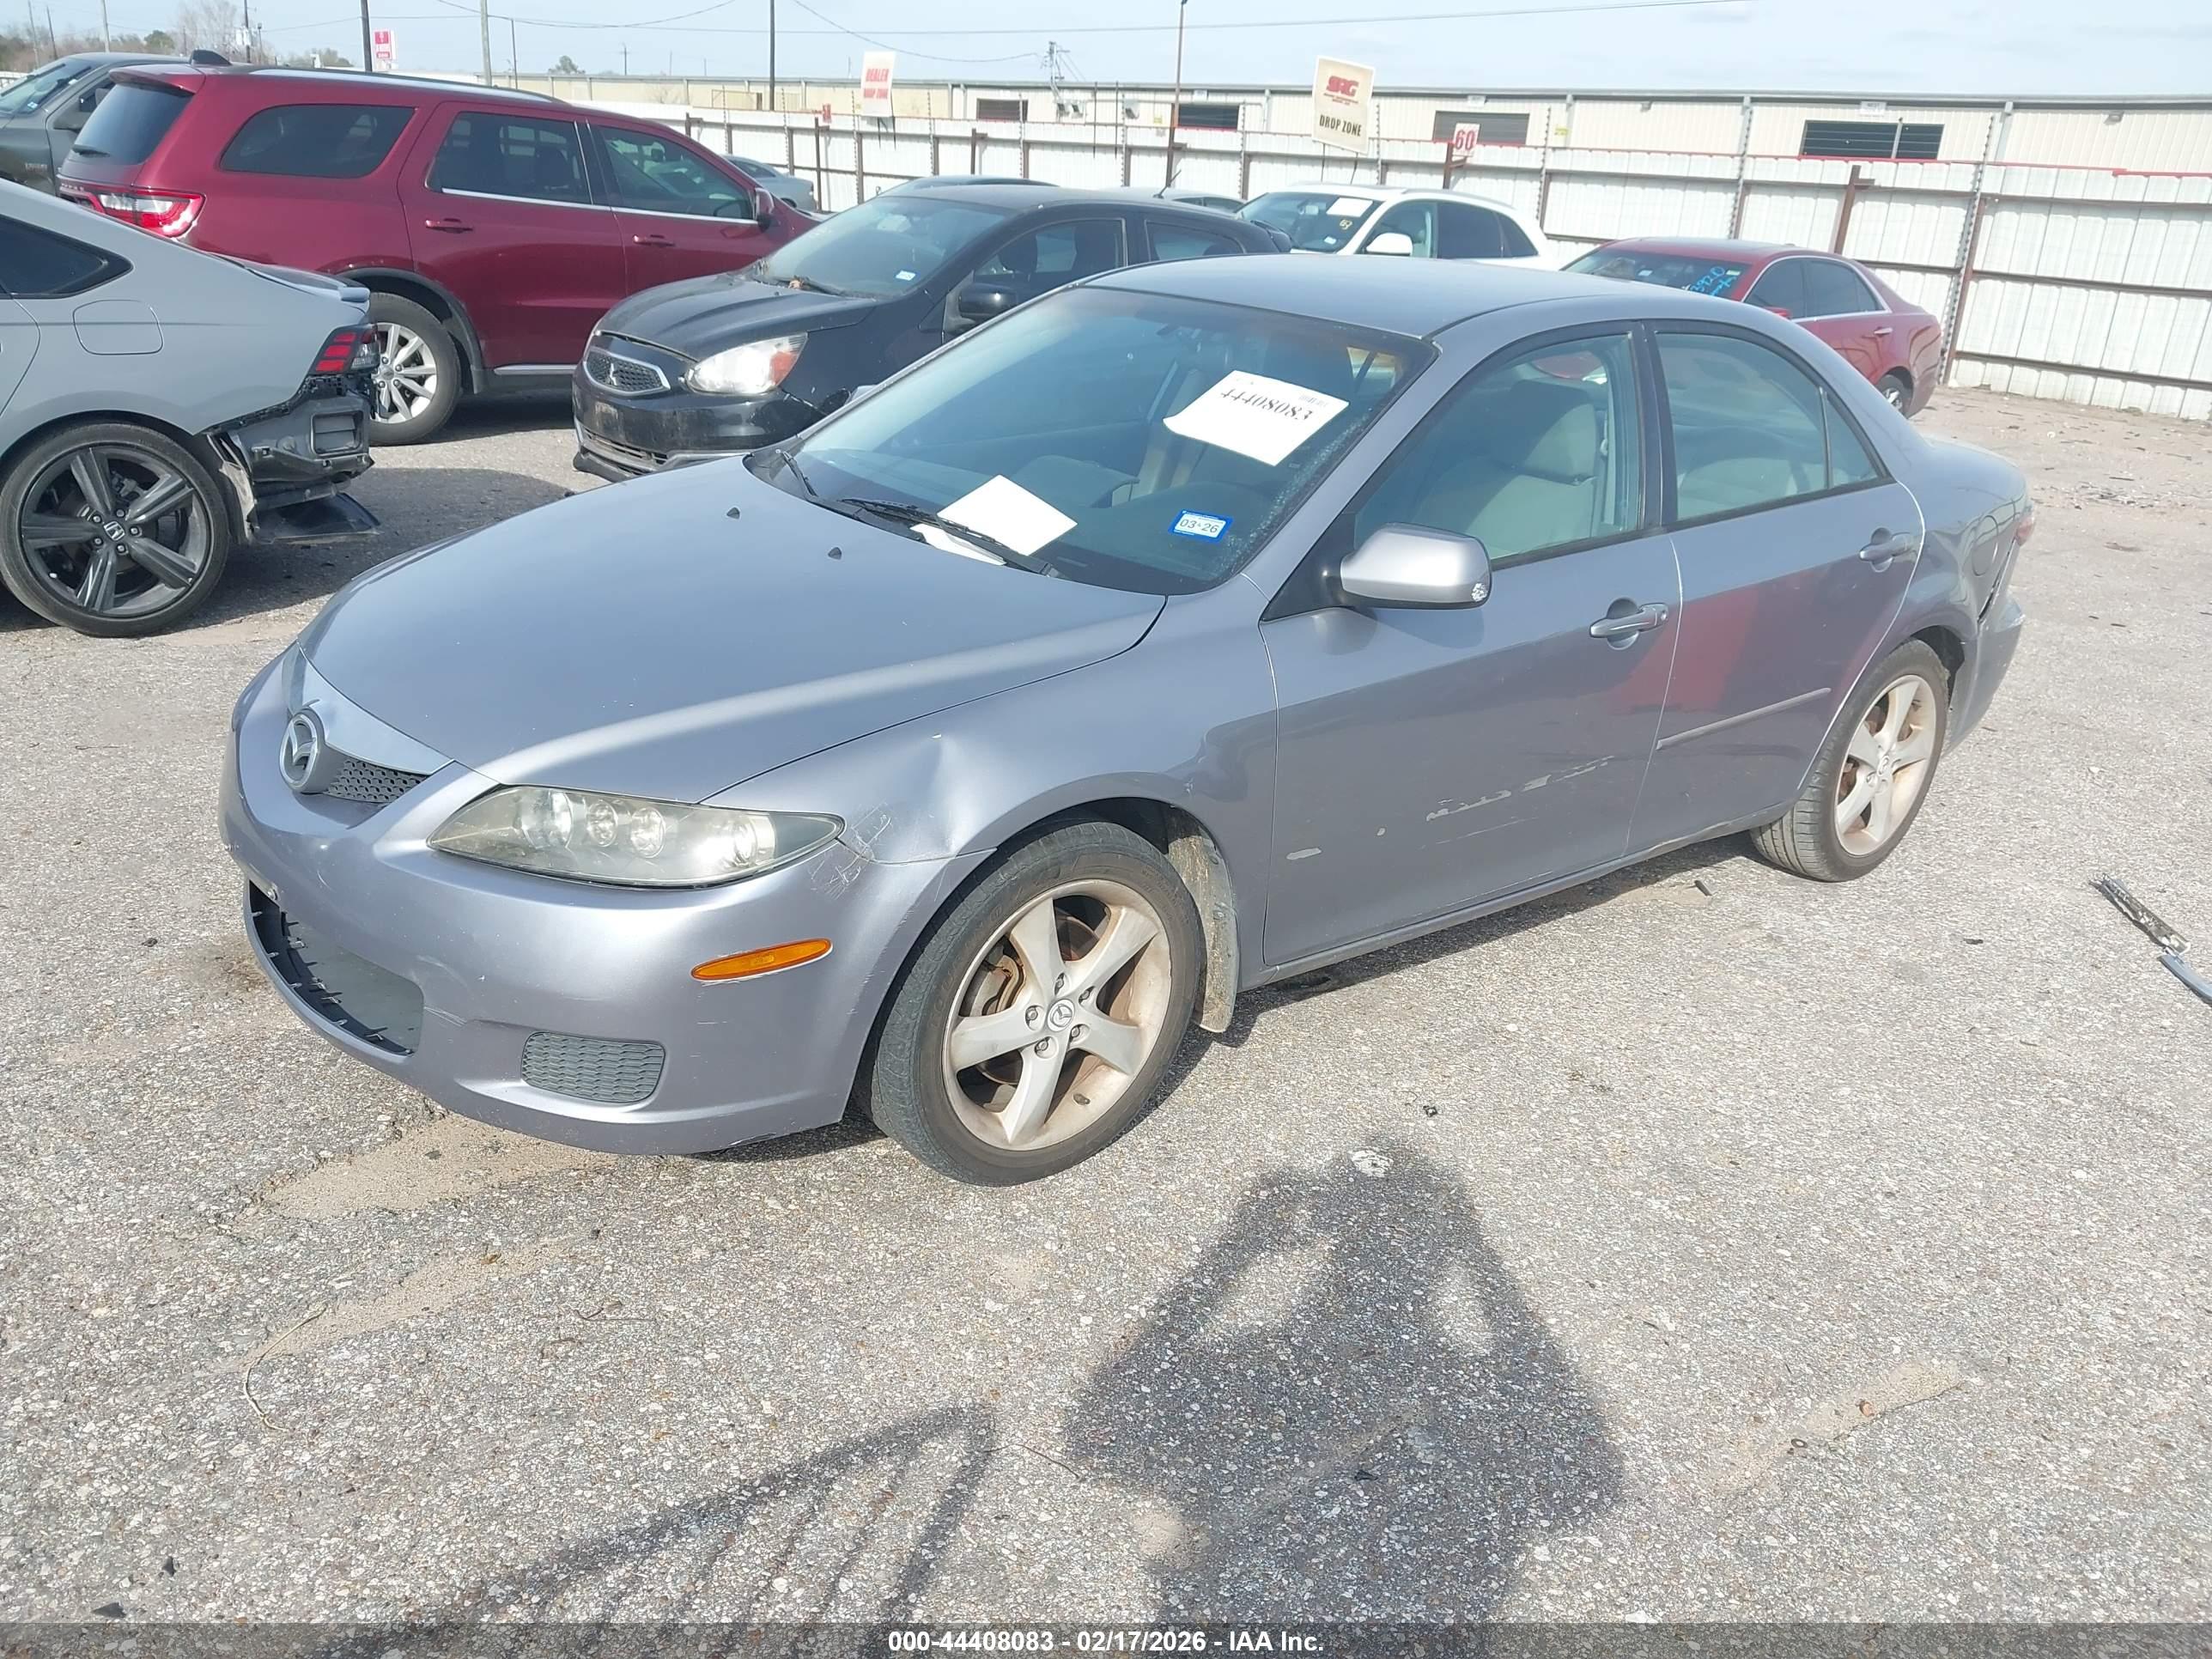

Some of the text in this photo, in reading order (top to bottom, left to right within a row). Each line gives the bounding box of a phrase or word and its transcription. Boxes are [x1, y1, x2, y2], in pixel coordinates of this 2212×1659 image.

[1319, 114, 1362, 137] DROP ZONE
[1455, 130, 1476, 150] 60
[1220, 388, 1314, 421] 44408083
[1180, 519, 1198, 529] 03
[1201, 522, 1220, 533] 26
